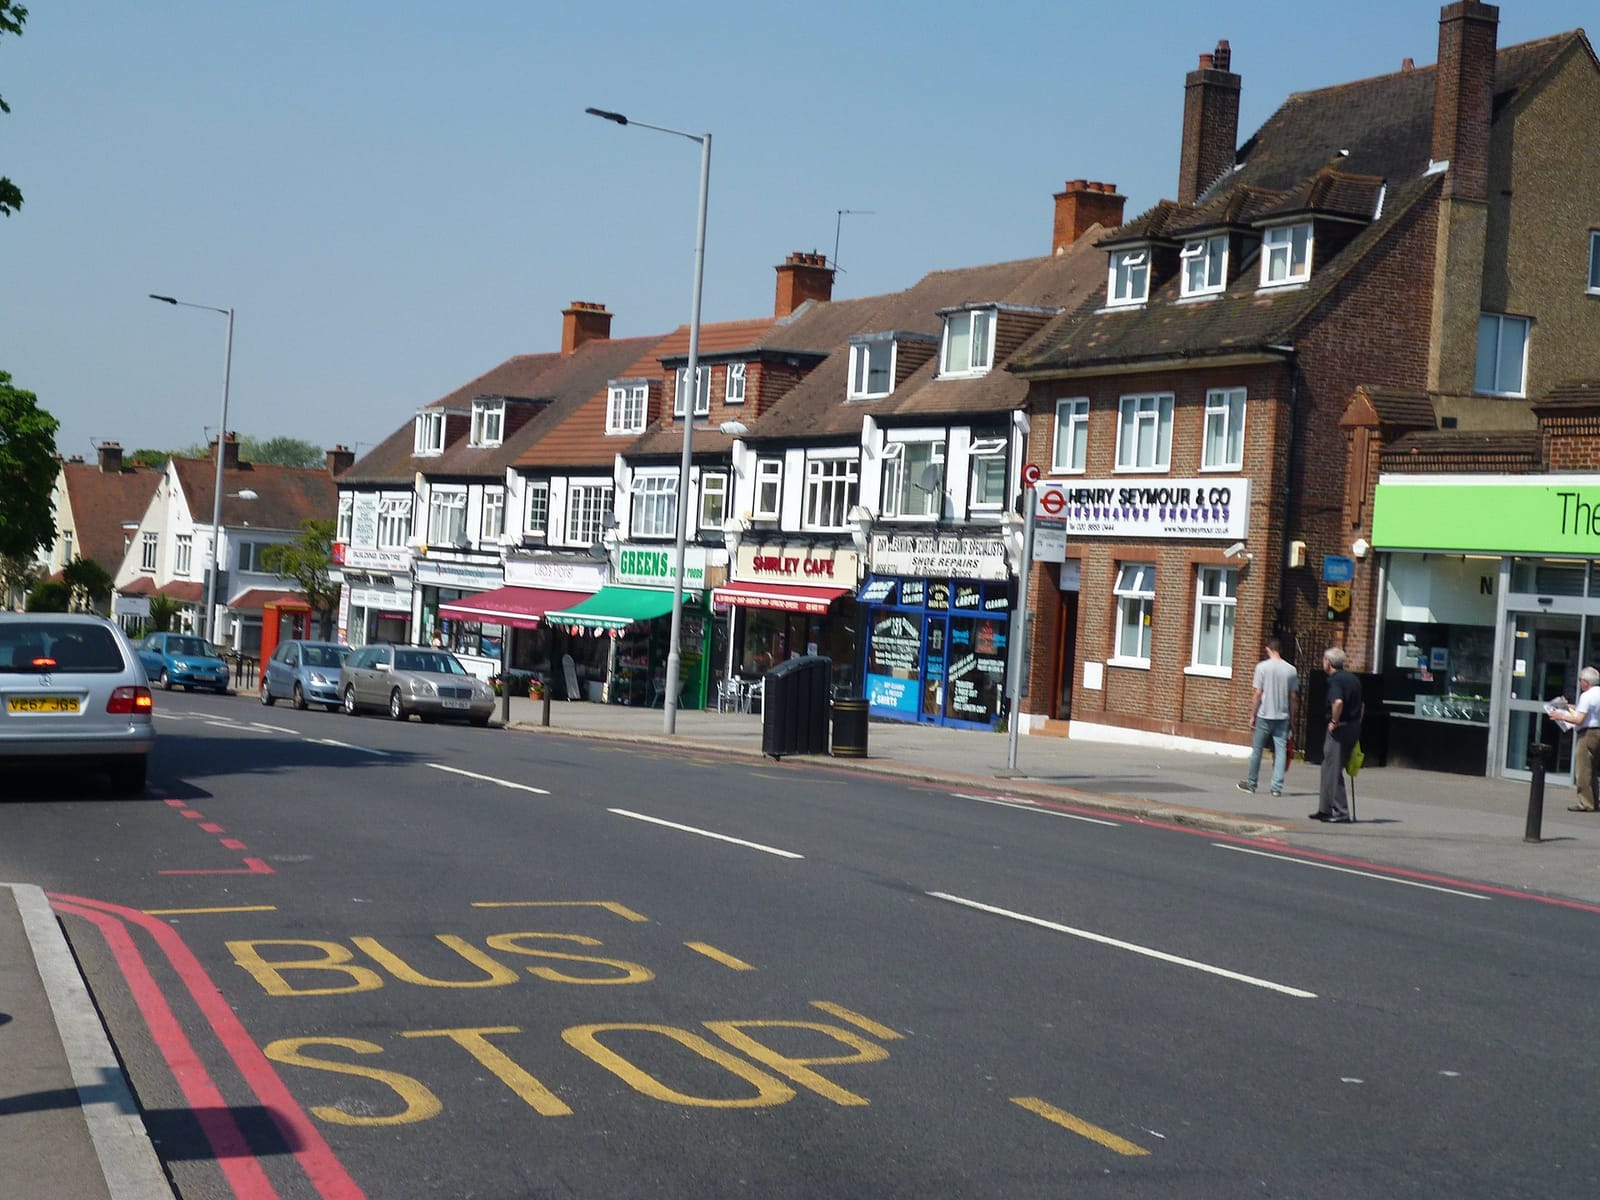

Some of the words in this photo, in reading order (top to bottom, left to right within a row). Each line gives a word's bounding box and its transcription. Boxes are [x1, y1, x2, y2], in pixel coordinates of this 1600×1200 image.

[1069, 487, 1115, 505] HENRY
[1119, 487, 1190, 506] SEYMOUR
[1196, 487, 1205, 505] &
[1209, 487, 1231, 506] CO
[1159, 508, 1230, 523] BROKERS
[620, 550, 668, 577] GREENS
[753, 556, 800, 573] SHIRLEY
[803, 557, 834, 576] CAFE
[912, 556, 935, 567] SHOE
[937, 558, 980, 569] REPAIRS
[956, 594, 980, 608] CARPET
[224, 931, 656, 997] BUS
[263, 1020, 891, 1128] STOP
